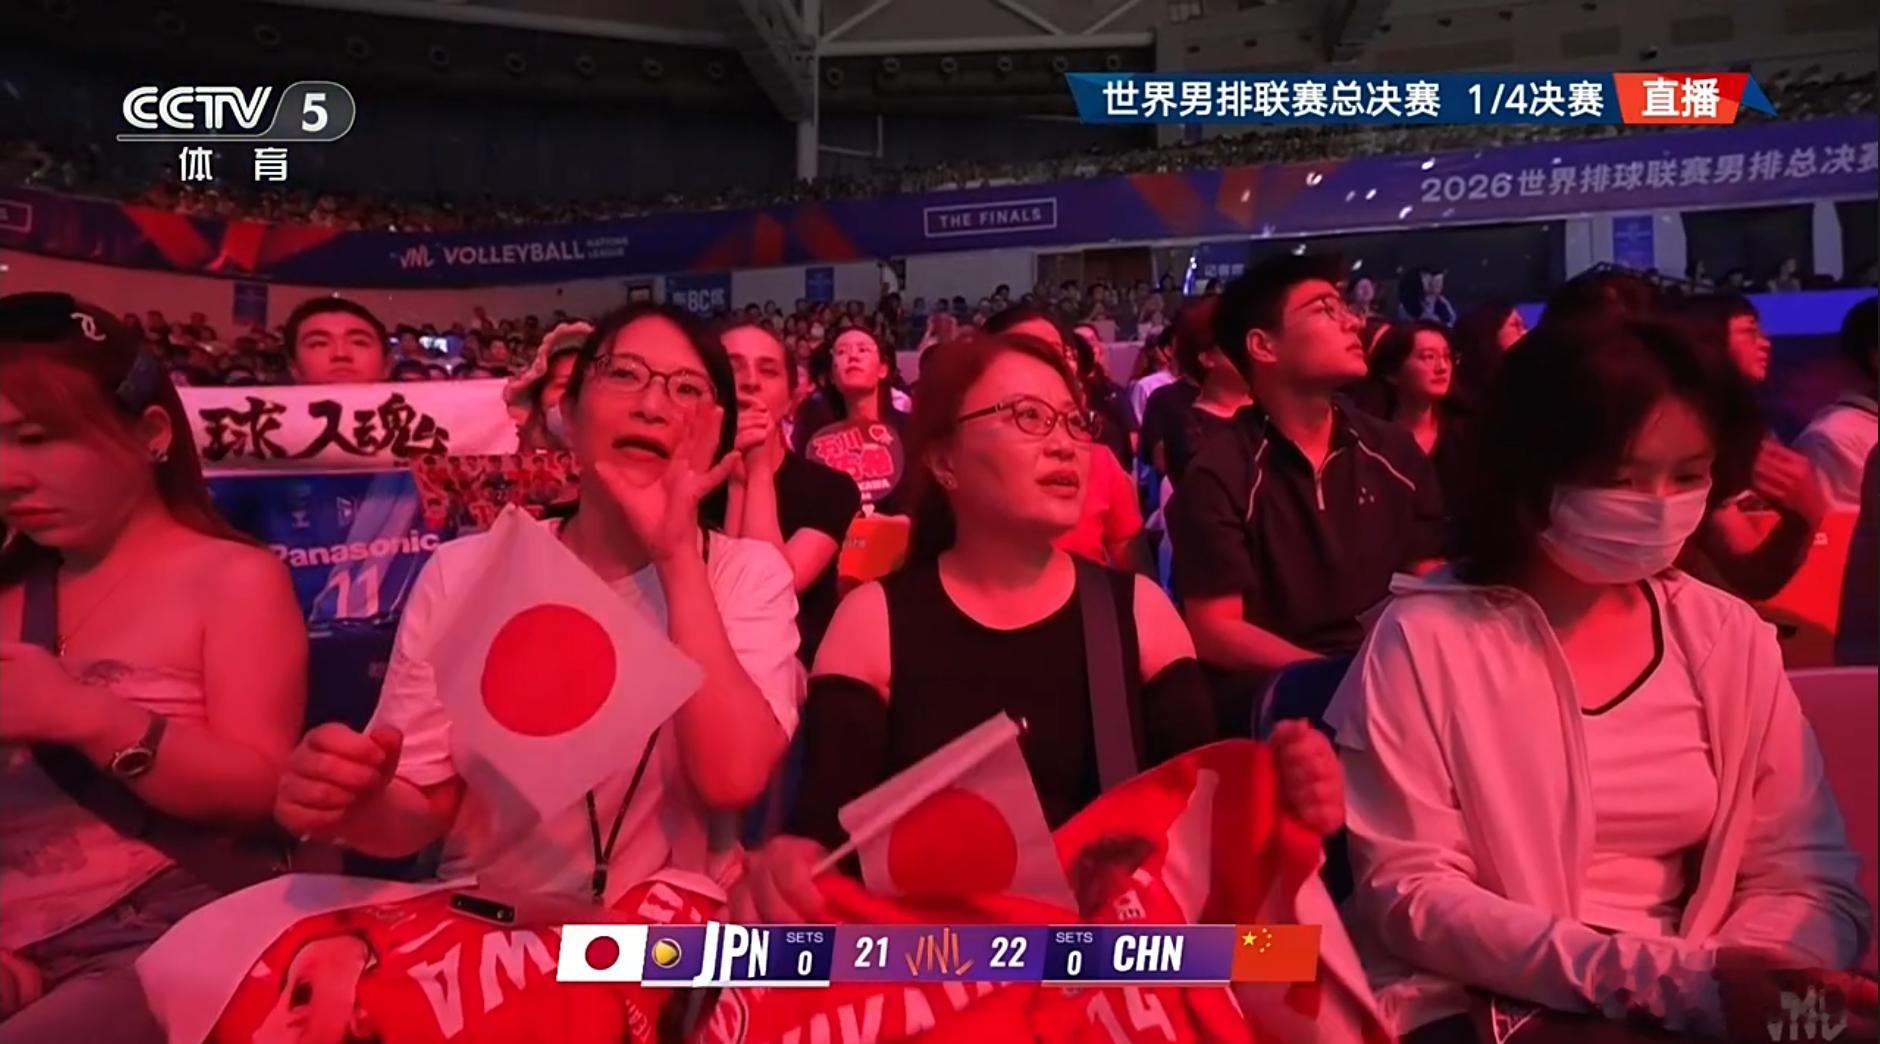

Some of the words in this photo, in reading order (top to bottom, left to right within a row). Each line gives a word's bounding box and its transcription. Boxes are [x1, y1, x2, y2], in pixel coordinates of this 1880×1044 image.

[939, 213, 972, 229] THE
[979, 206, 1042, 227] FINALS
[442, 240, 585, 265] VOLLEYBALL
[268, 530, 441, 568] Panasonic
